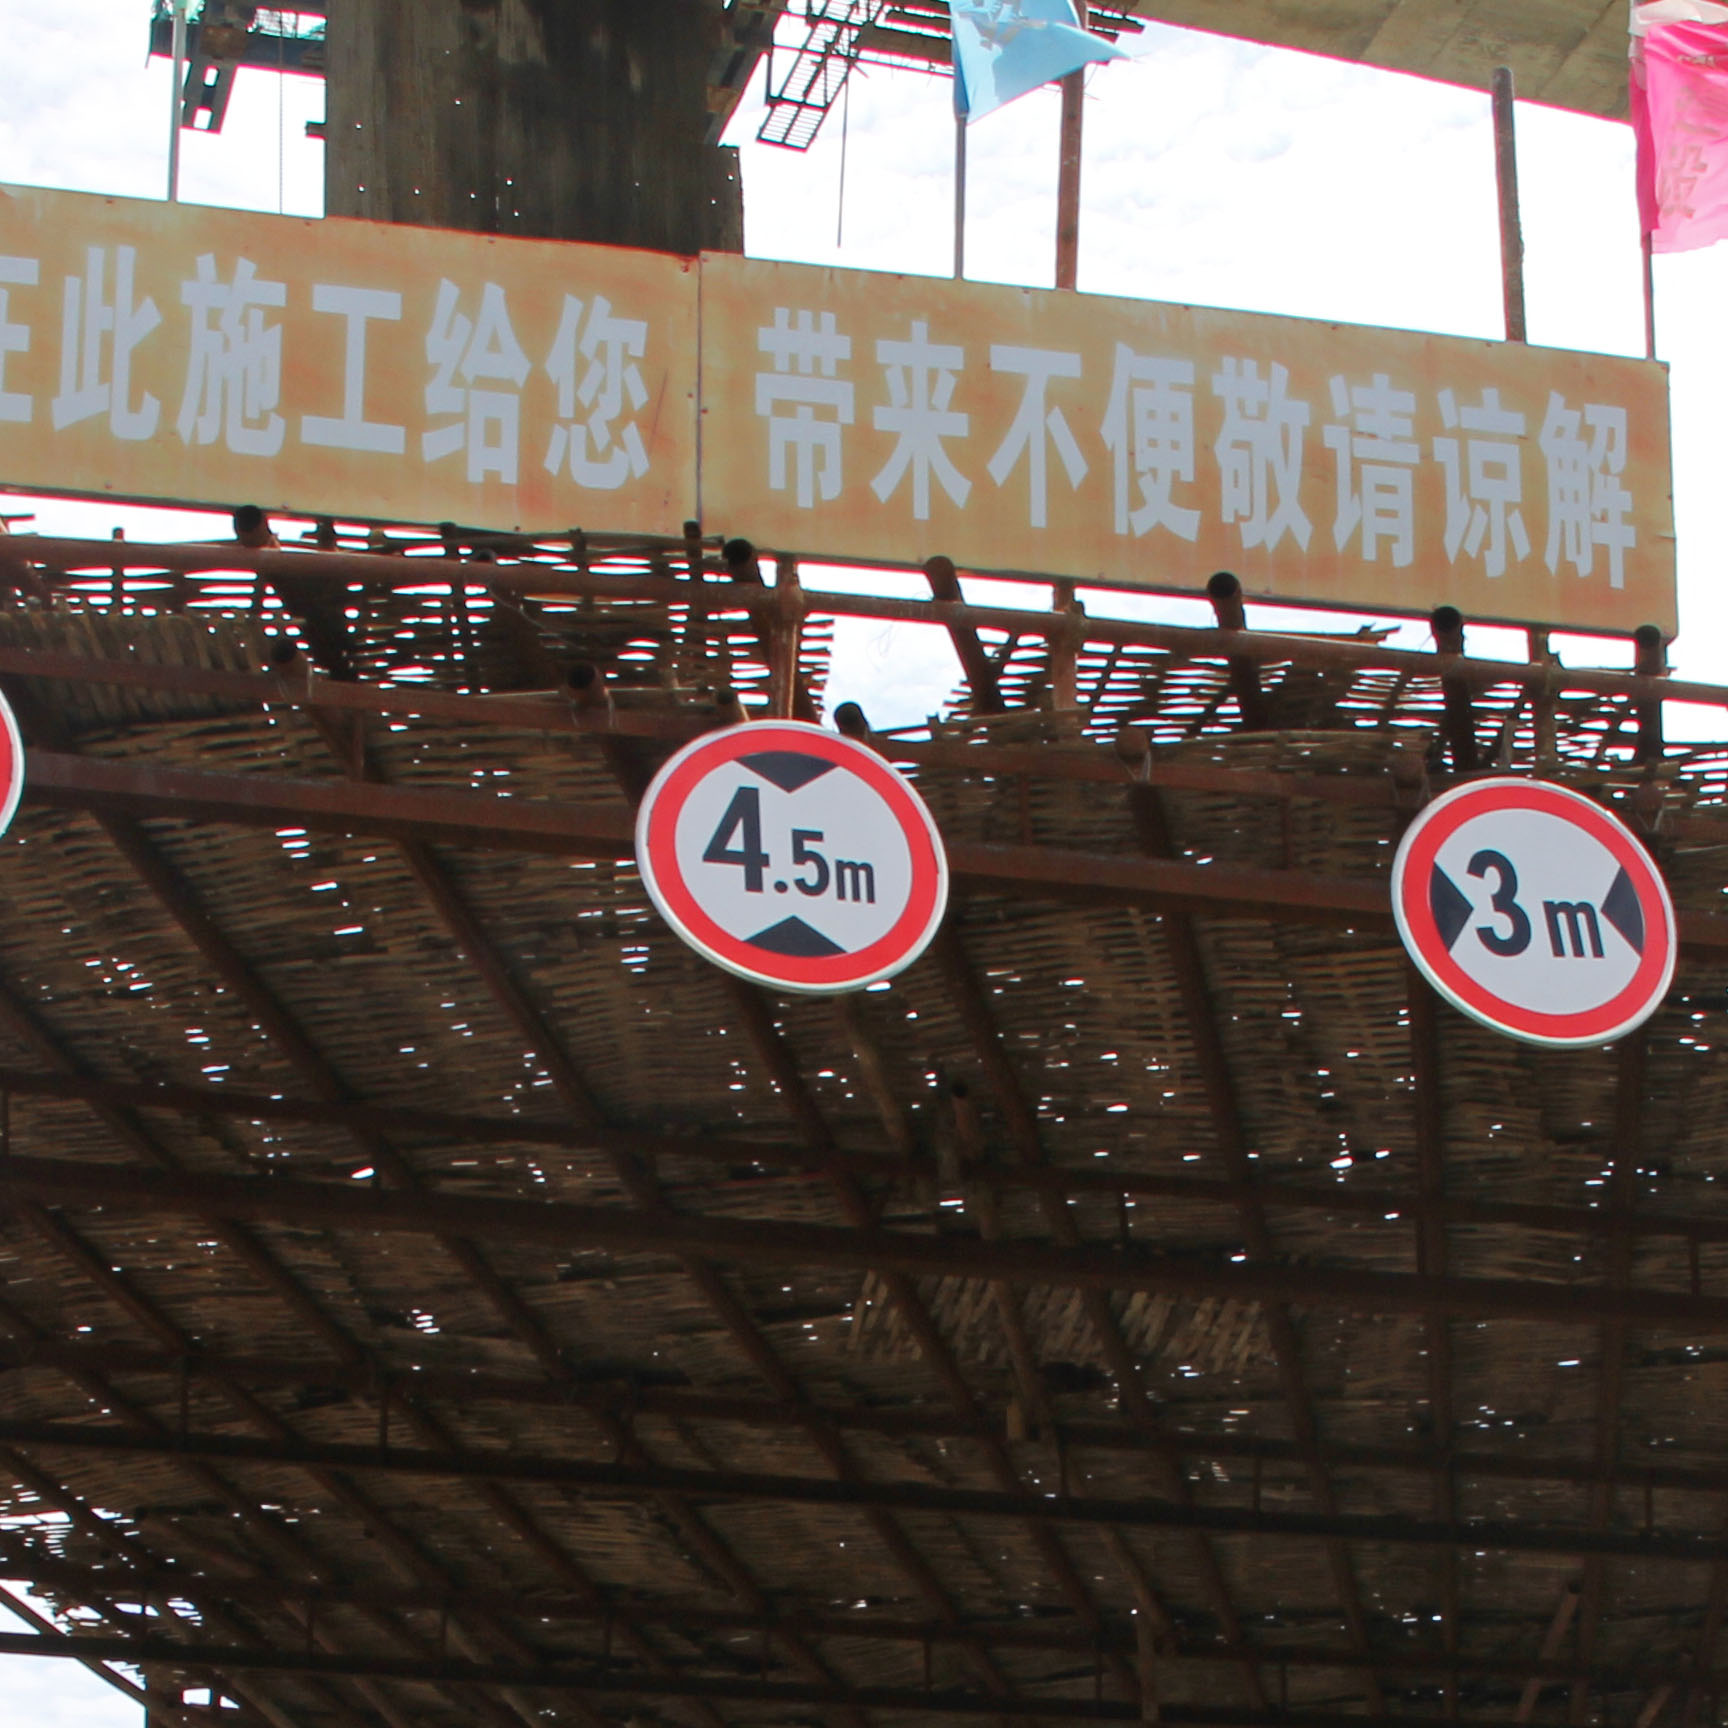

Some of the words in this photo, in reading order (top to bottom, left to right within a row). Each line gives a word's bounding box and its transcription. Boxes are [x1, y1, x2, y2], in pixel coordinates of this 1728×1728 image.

[754, 305, 1637, 589] 带来不便敬请谅解
[702, 786, 876, 904] 4.5m
[1466, 848, 1606, 959] 3m
